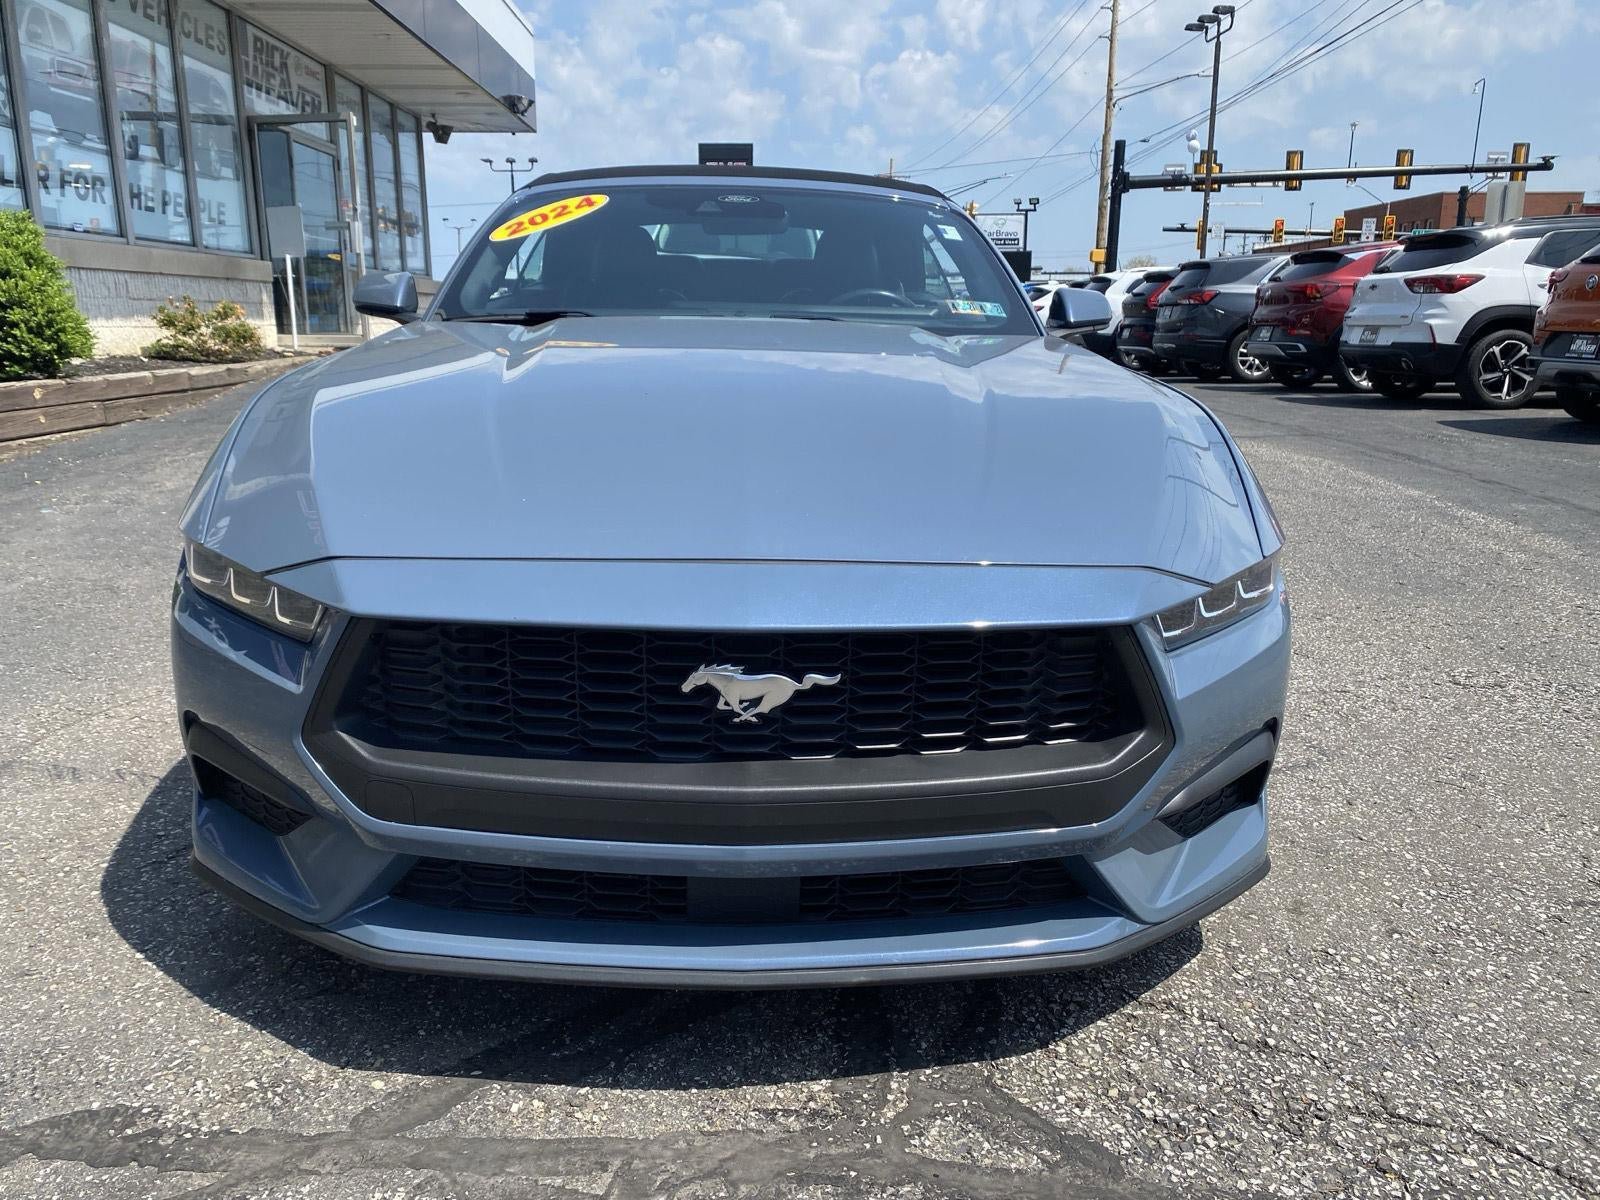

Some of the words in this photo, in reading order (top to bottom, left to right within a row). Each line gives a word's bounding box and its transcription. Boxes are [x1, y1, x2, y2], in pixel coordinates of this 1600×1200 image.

[252, 33, 291, 72] RICK
[243, 56, 321, 113] WEAVER
[59, 168, 106, 204] FOR
[129, 182, 156, 213] HE
[161, 190, 226, 226] PEPLE
[505, 196, 597, 237] 2024
